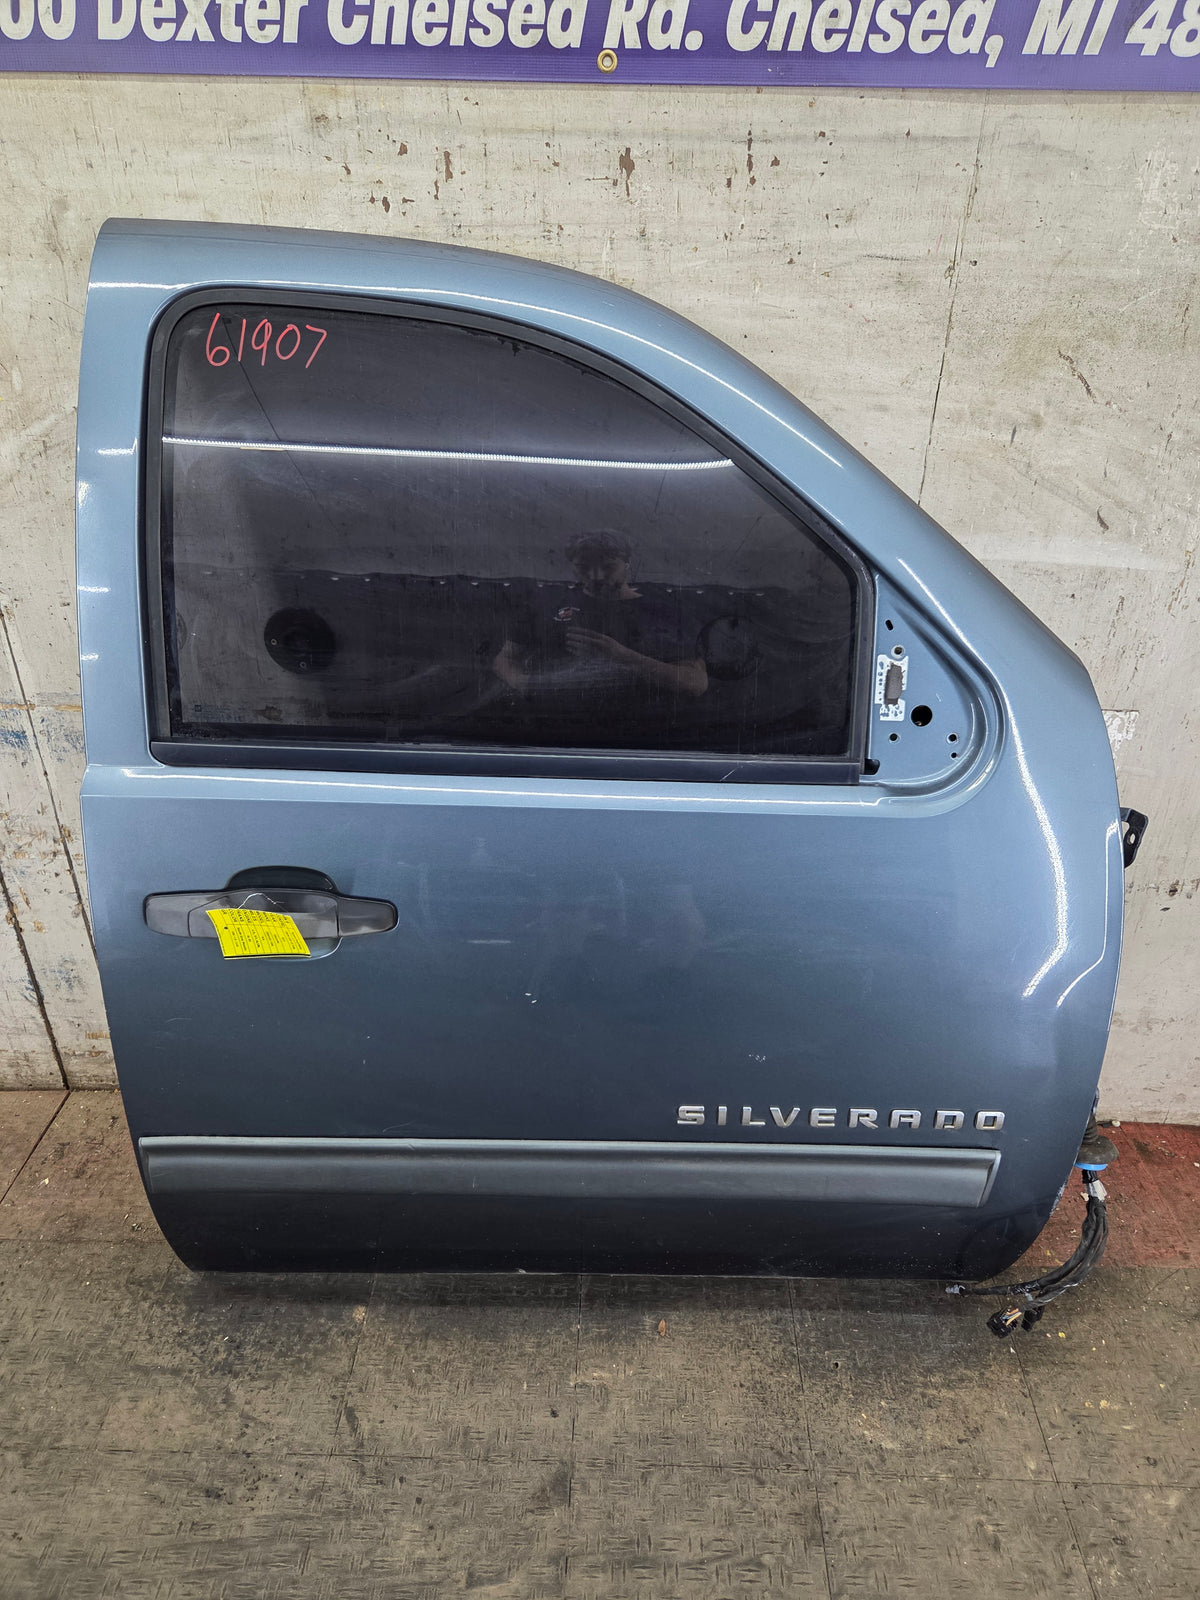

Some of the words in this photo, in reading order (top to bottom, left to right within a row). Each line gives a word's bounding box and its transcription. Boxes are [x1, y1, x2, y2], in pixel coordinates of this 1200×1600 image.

[98, 0, 308, 43] Dexter
[327, 0, 588, 49] Chelsea
[602, 0, 703, 51] Rd.
[726, 0, 1004, 68] Chelsea,
[1022, 0, 1120, 56] MI
[205, 312, 328, 369] 61907
[677, 1105, 1006, 1131] SILVERADO
